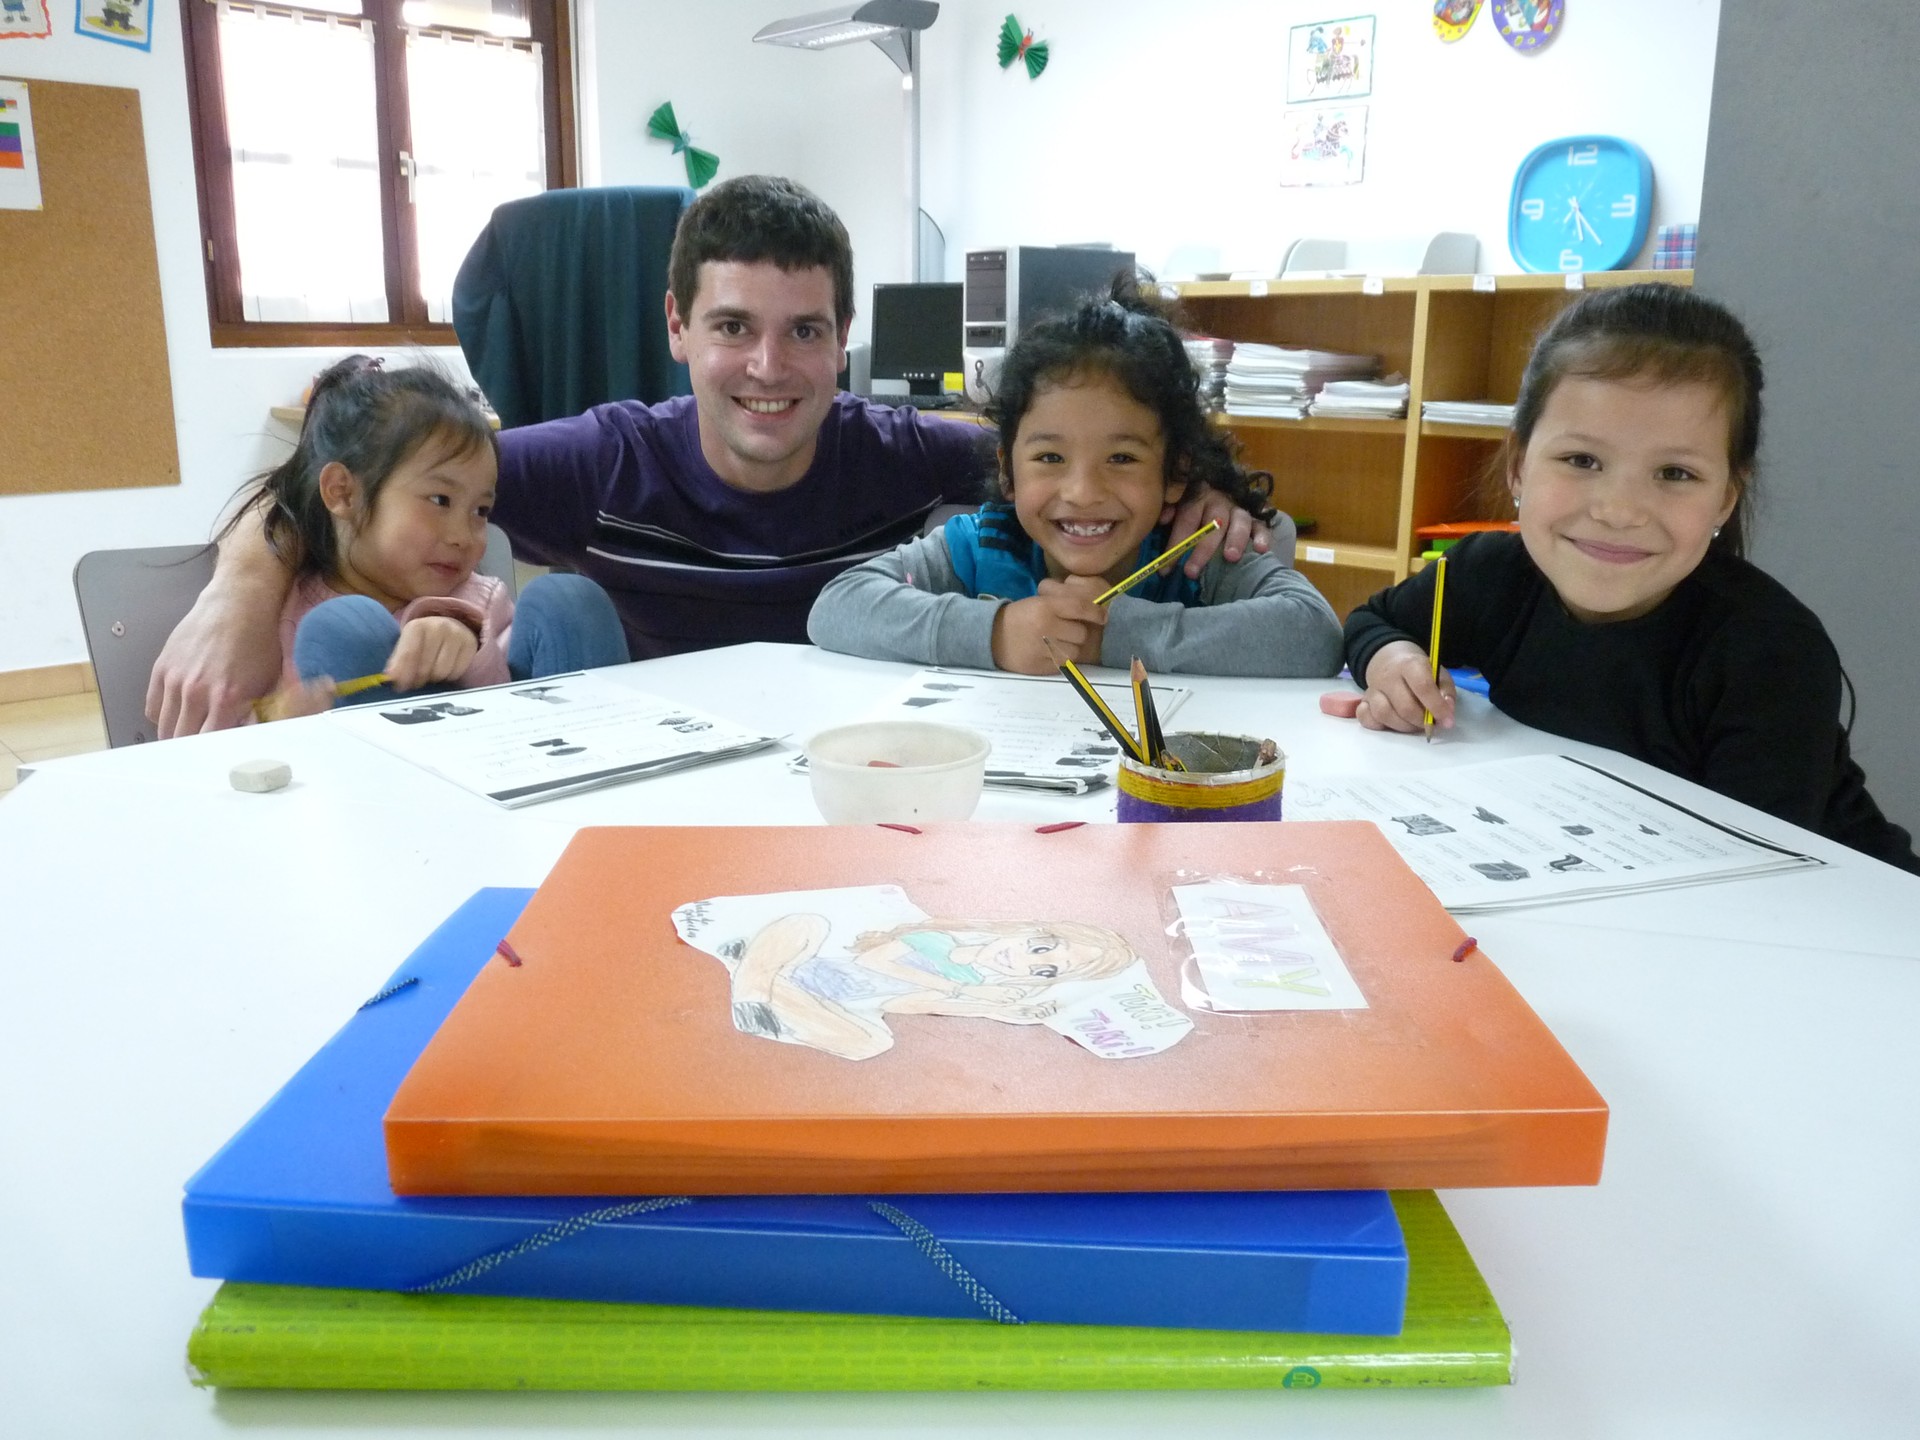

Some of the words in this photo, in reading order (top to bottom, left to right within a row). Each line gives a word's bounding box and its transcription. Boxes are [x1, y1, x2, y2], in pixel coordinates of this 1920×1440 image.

[1567, 144, 1599, 167] 12
[1521, 198, 1545, 221] 9
[1611, 194, 1637, 219] 3
[1558, 249, 1584, 271] 6
